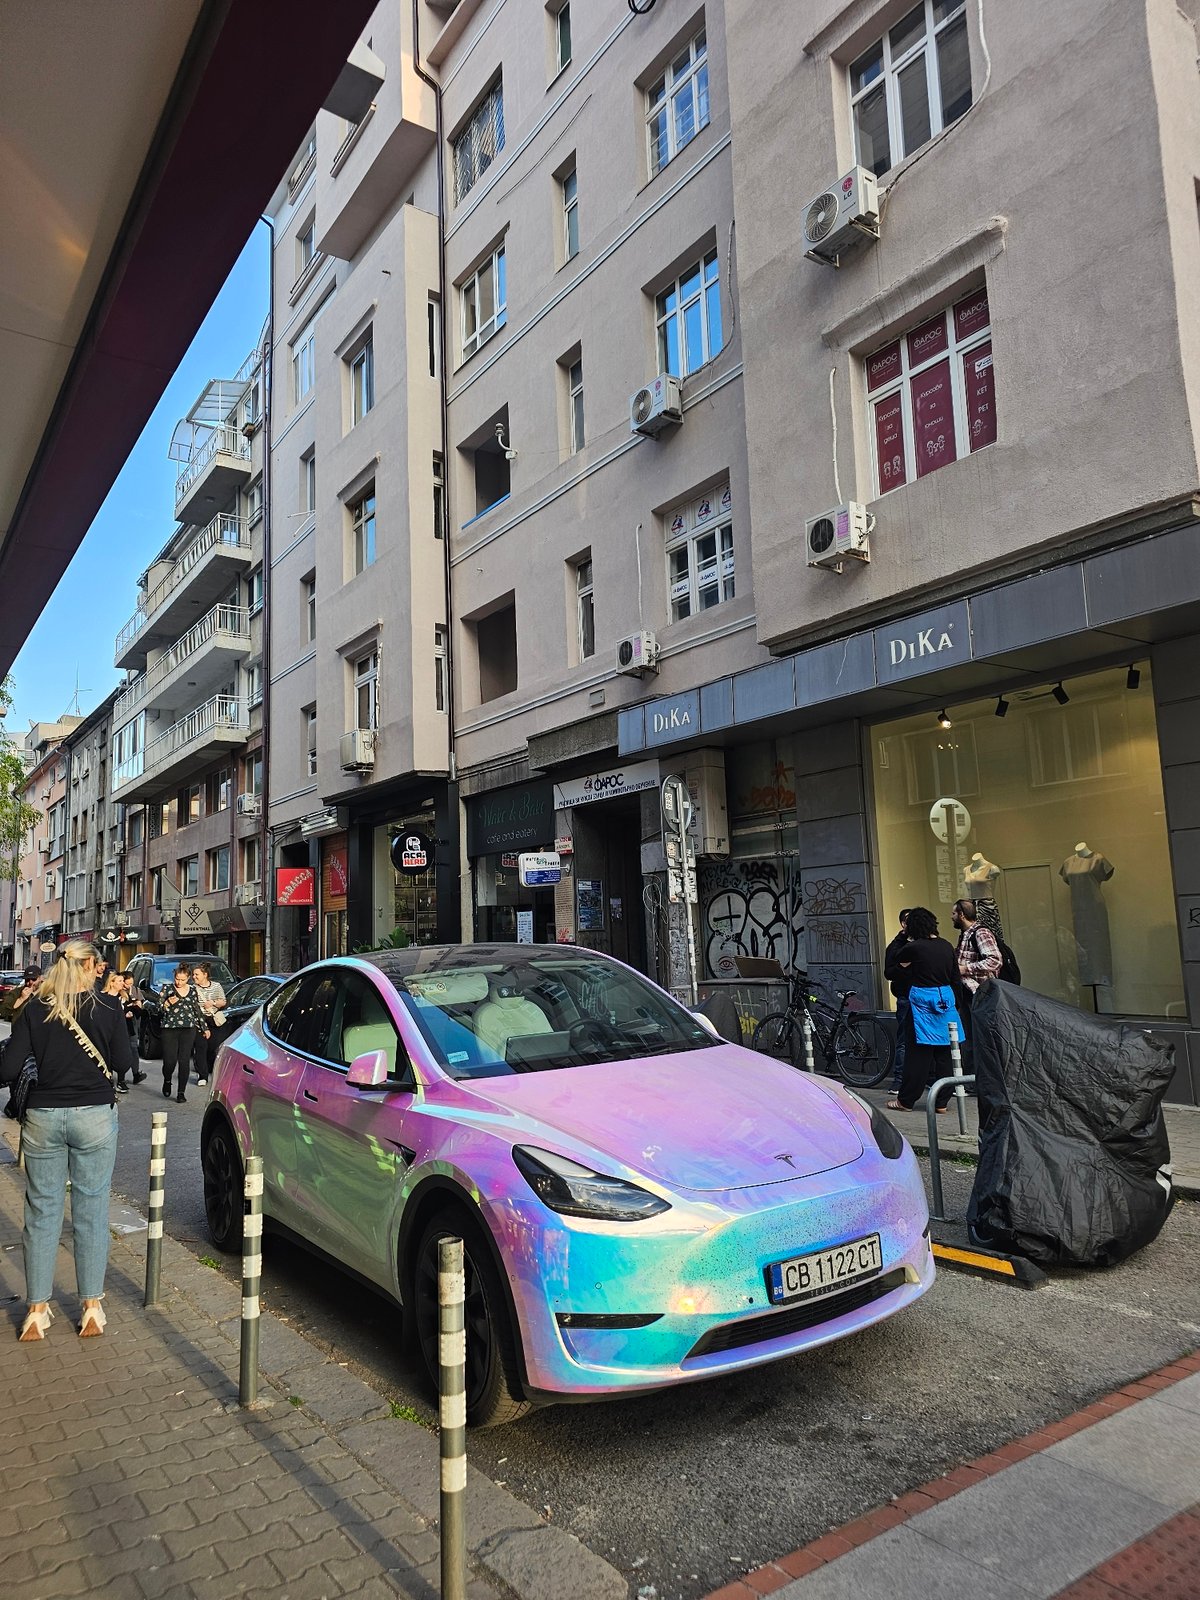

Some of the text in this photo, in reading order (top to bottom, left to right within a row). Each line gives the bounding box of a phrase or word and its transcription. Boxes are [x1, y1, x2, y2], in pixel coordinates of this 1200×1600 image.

[844, 190, 852, 200] LG
[914, 326, 942, 348] ФАРОС
[872, 353, 898, 372] ФАРОС
[976, 386, 988, 396] KET
[978, 403, 989, 413] PET
[594, 774, 624, 791] ФАРОС
[786, 1240, 876, 1291] CB 1122 CT
[773, 1286, 782, 1295] BG
